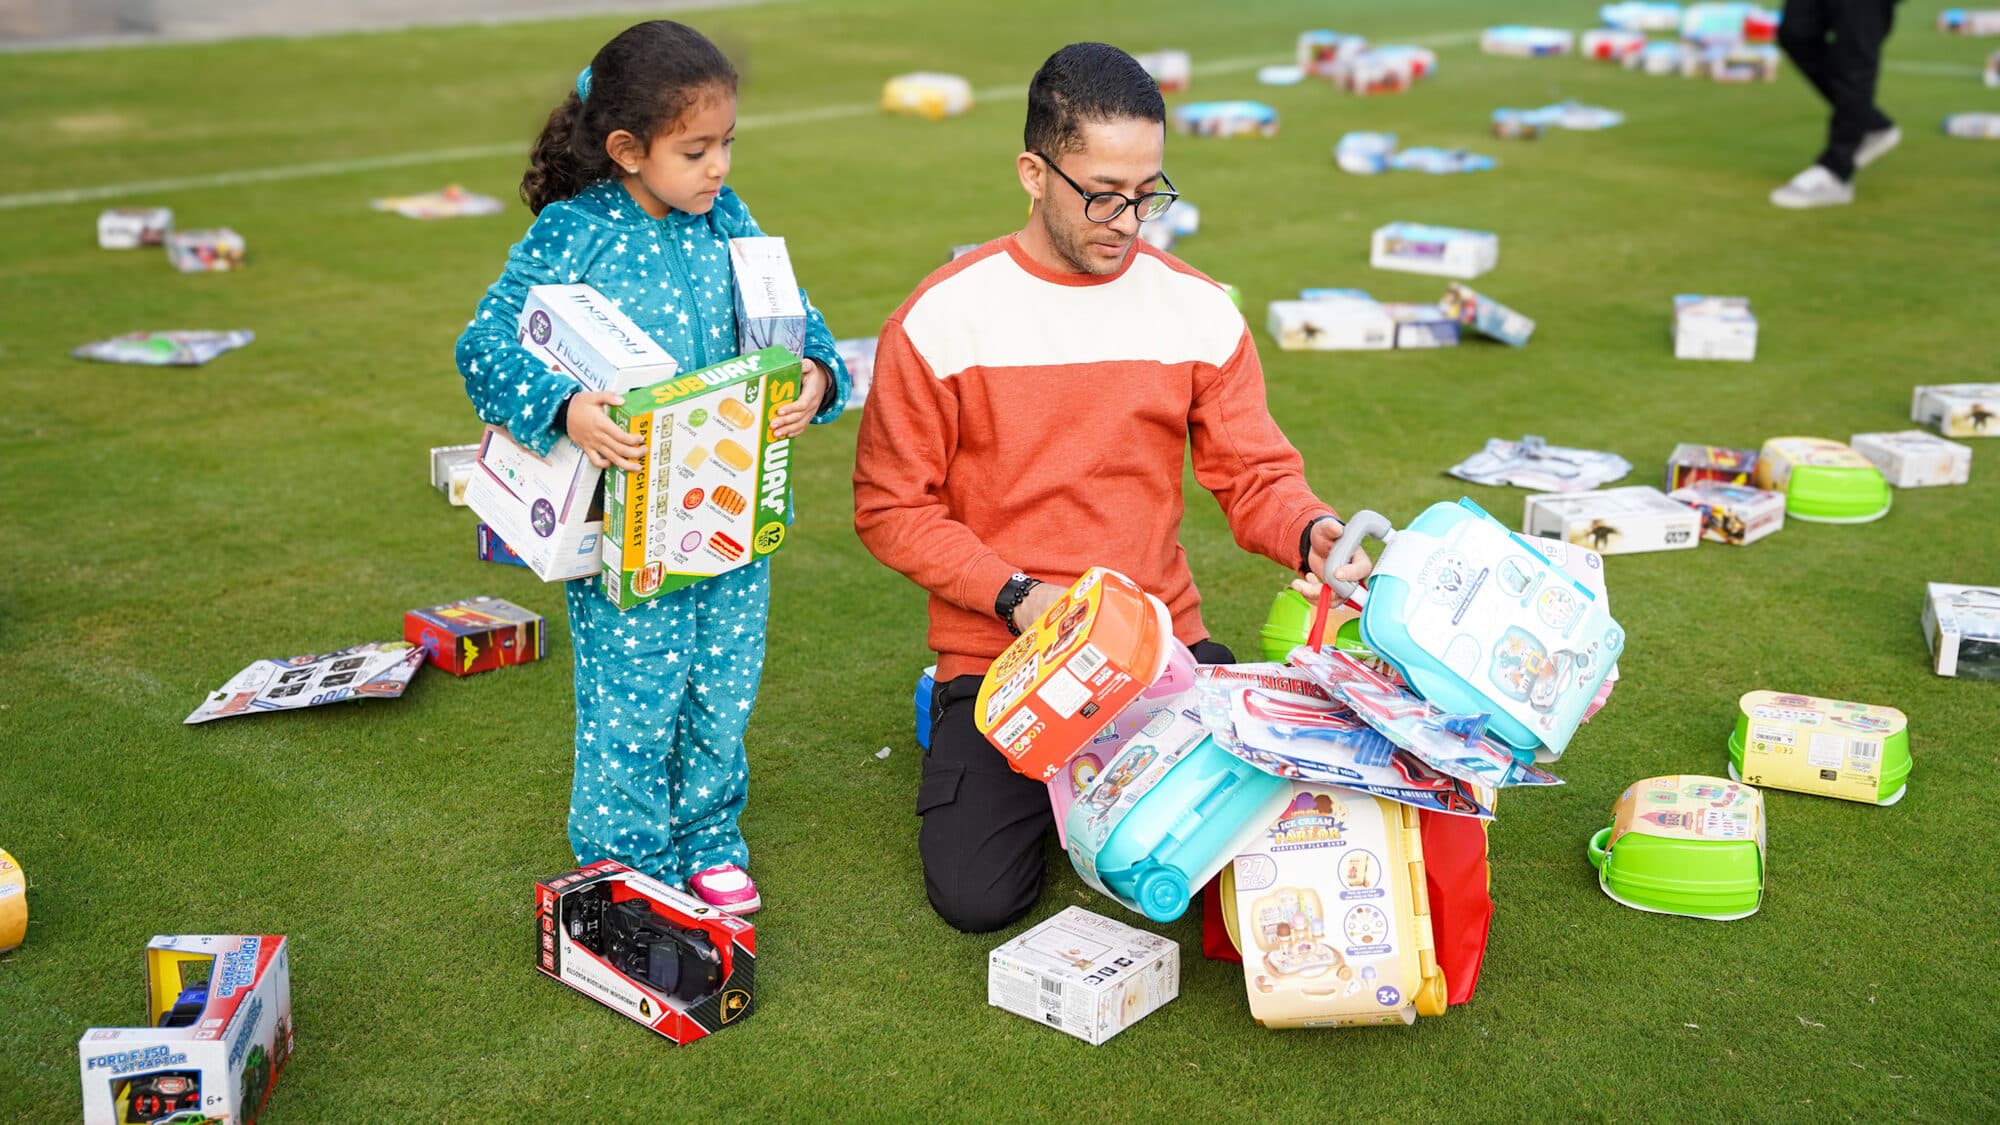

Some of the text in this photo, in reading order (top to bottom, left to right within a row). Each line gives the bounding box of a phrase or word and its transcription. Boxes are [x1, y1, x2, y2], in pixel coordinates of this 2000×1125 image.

[584, 305, 648, 354] FROZEN
[556, 338, 597, 384] FROZEN
[651, 354, 761, 404] SUBWAY
[746, 385, 759, 403] 3+
[633, 494, 645, 547] PLAYSET
[766, 526, 781, 547] 12
[1209, 665, 1332, 702] AVENGERS
[1043, 763, 1060, 778] 3+
[1747, 775, 1763, 784] 3+
[1367, 784, 1435, 800] CAPTAIN AMERICA
[1279, 816, 1333, 832] ICE CREAM
[1275, 827, 1342, 844] PARLOR
[1239, 857, 1266, 878] 27
[240, 936, 259, 960] FORD
[1377, 989, 1398, 1005] 3+
[87, 1045, 170, 1070] FORD F-150
[111, 1053, 188, 1075] SVT RAPTOR
[206, 1095, 223, 1106] 6+
